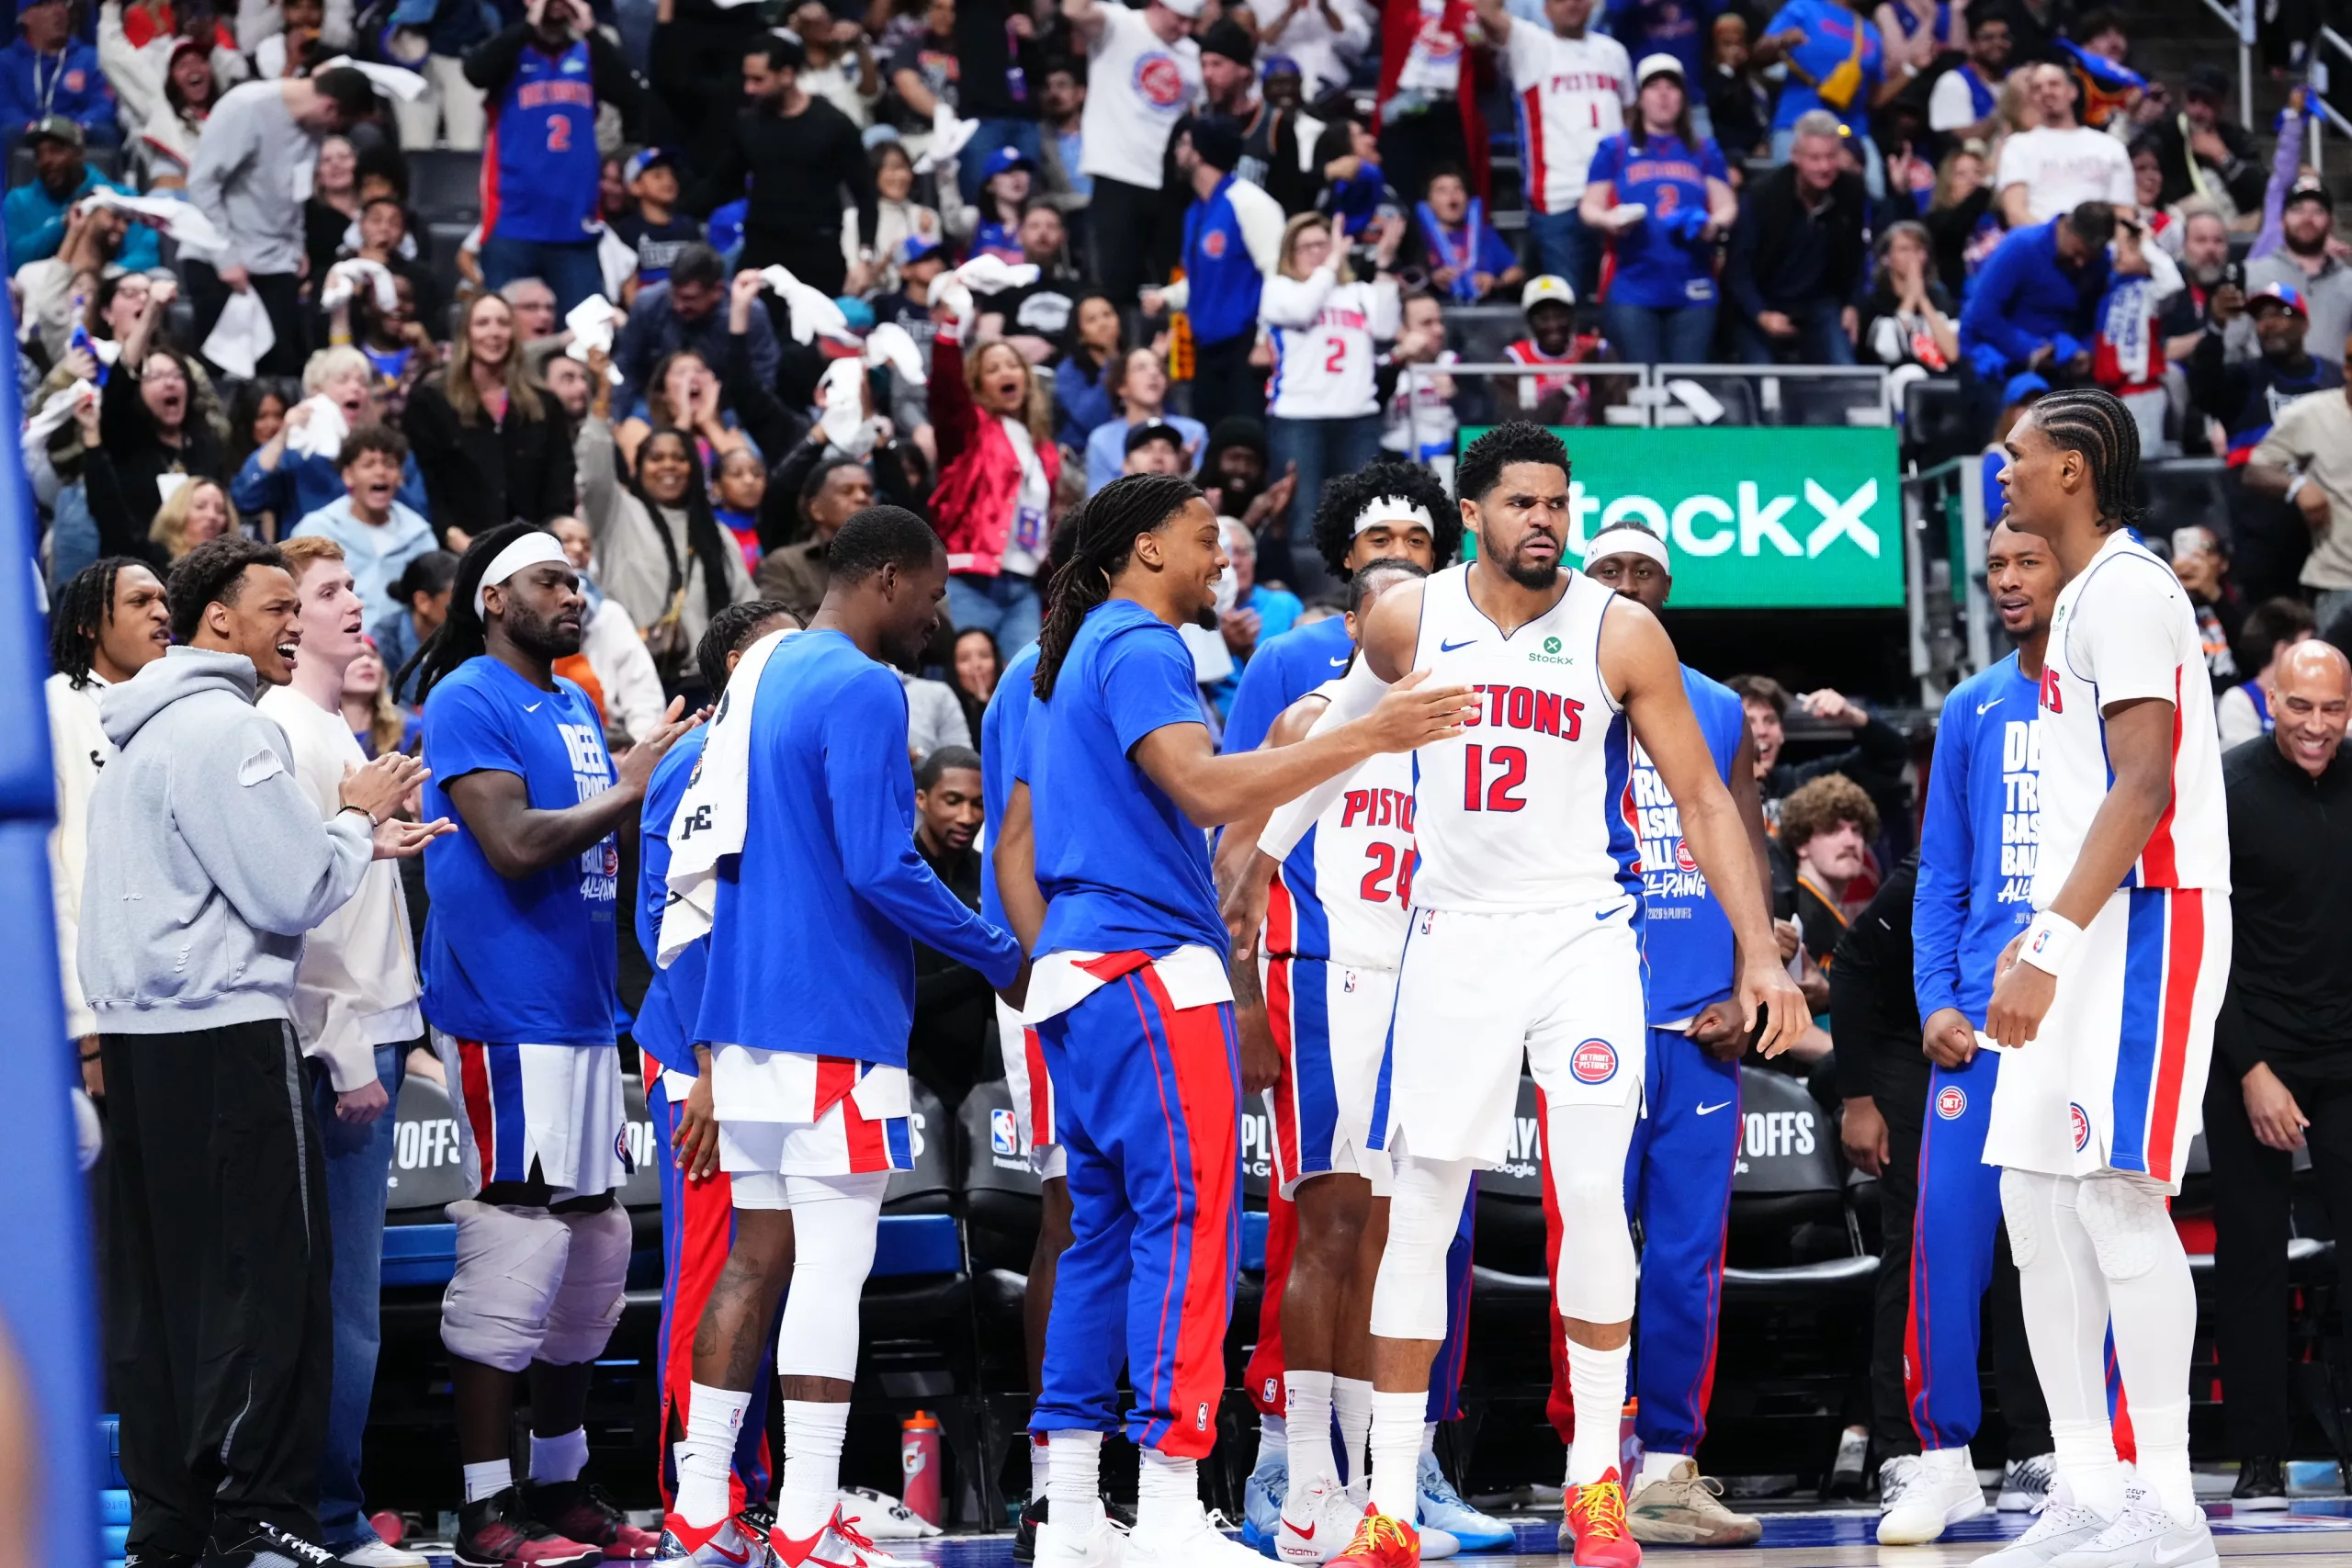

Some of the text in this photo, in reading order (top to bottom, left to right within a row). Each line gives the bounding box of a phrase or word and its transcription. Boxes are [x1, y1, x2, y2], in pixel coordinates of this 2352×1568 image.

[1590, 103, 1600, 129] 1
[547, 115, 571, 152] 2
[1655, 185, 1679, 220] 2
[1326, 338, 1345, 372] 2
[1559, 478, 1880, 558] tockX
[1529, 653, 1573, 665] StockX
[1452, 684, 1585, 742] STONS
[1464, 744, 1527, 813] 12
[1341, 788, 1414, 834] PISTO
[598, 876, 618, 902] DAW
[1361, 837, 1416, 911] 24
[1661, 871, 1707, 899] DAWG
[1577, 1061, 1610, 1070] PISTONS
[1578, 1054, 1610, 1063] DETROIT
[1942, 1097, 1960, 1109] DET
[394, 1118, 461, 1169] OFFS
[1740, 1111, 1815, 1157] OFFS
[1493, 1161, 1536, 1179] oogle
